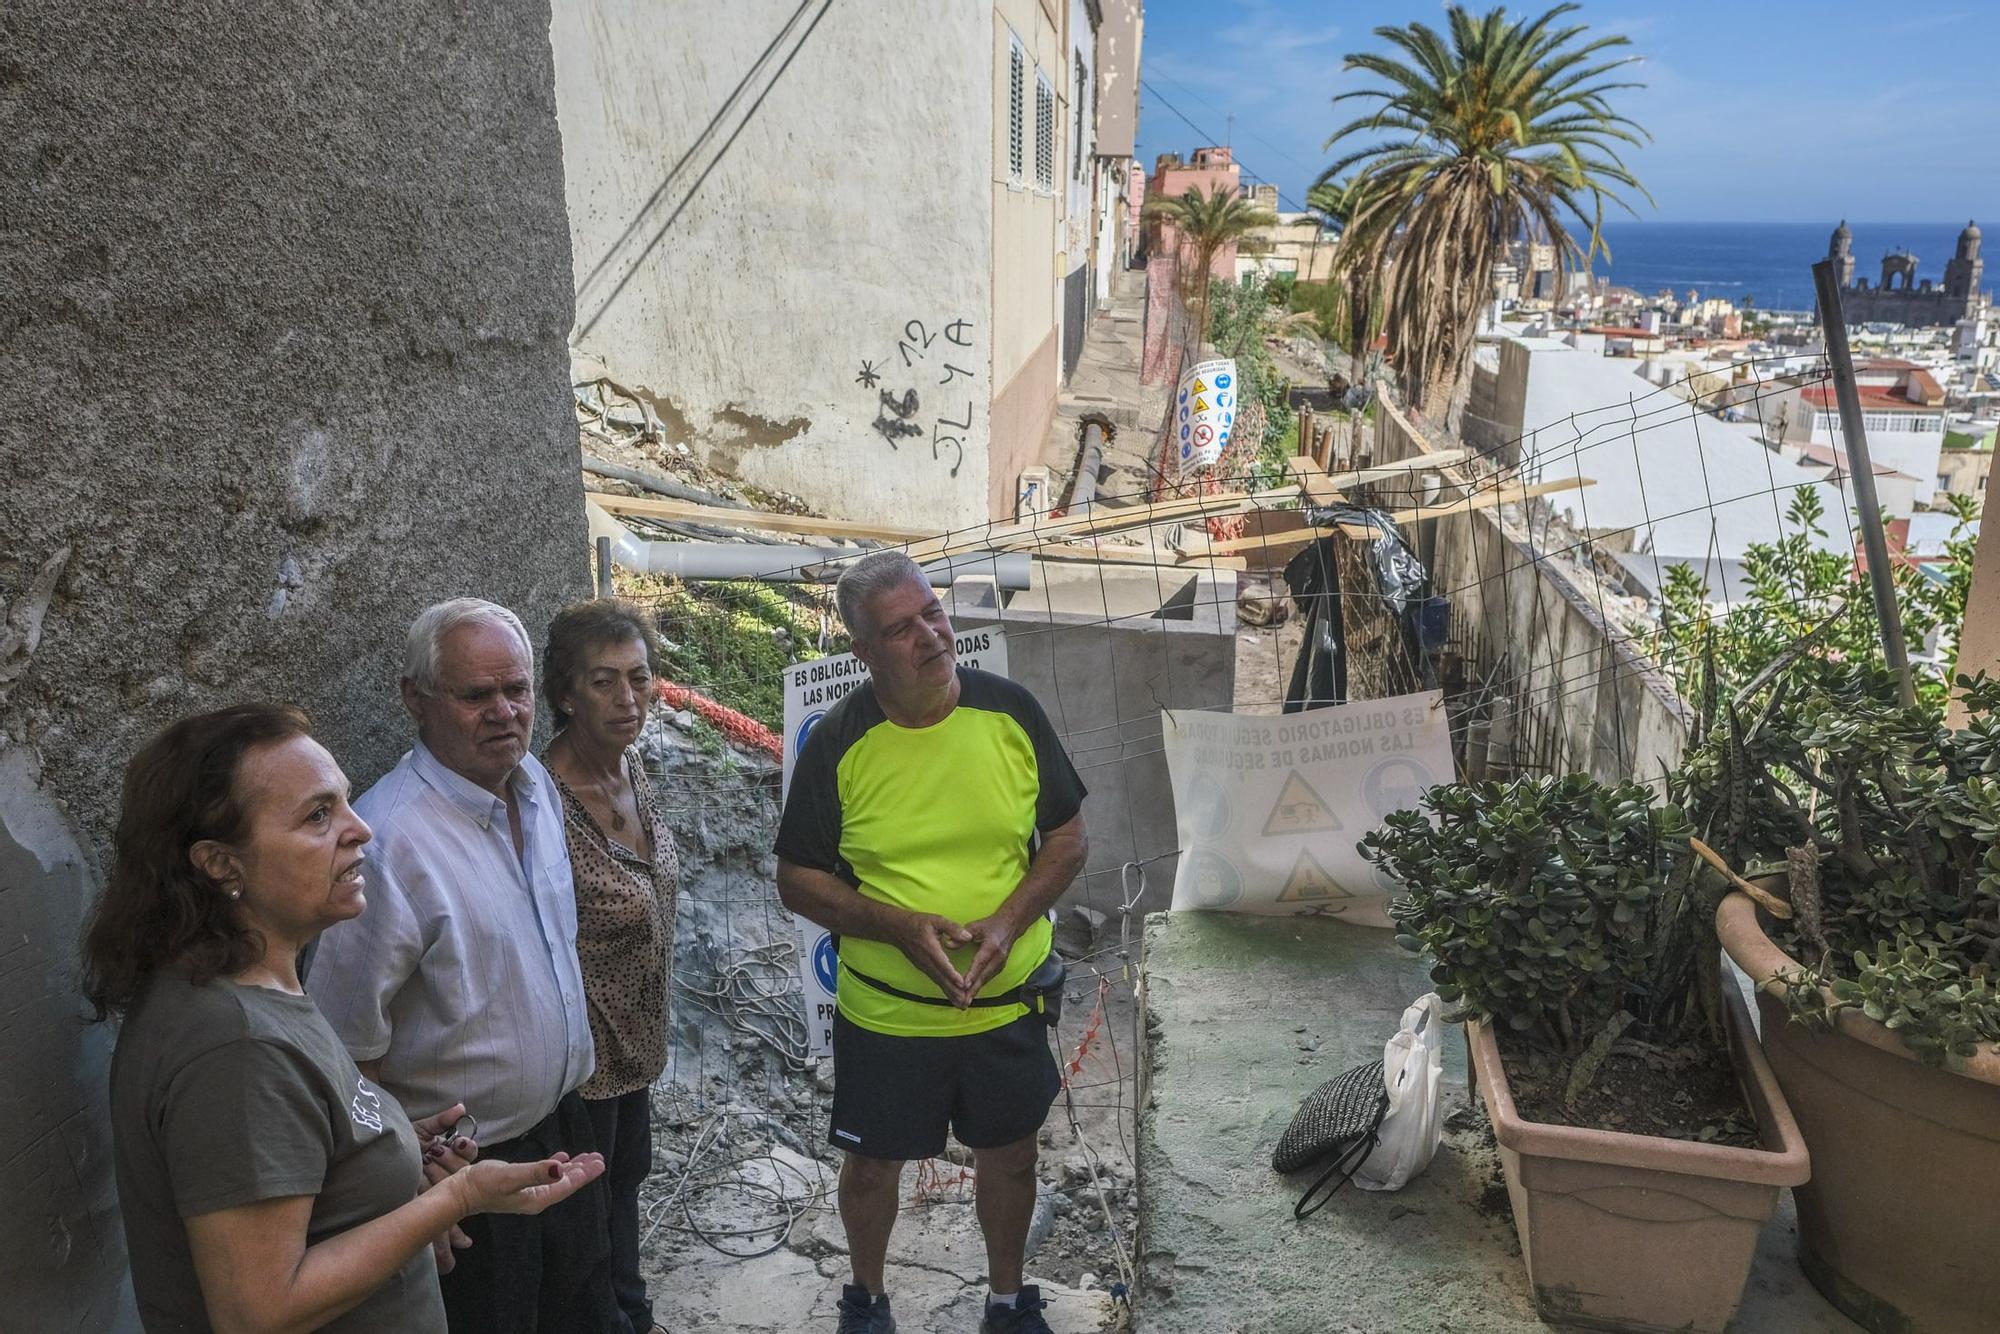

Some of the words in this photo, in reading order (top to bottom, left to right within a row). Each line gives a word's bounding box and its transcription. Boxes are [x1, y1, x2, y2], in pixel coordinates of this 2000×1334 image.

[899, 319, 937, 368] 12
[945, 318, 974, 347] A
[795, 667, 808, 687] ES
[810, 658, 867, 684] OBLIGATO
[955, 633, 990, 656] ODAS
[803, 685, 822, 706] LAS
[352, 1073, 383, 1135] BES
